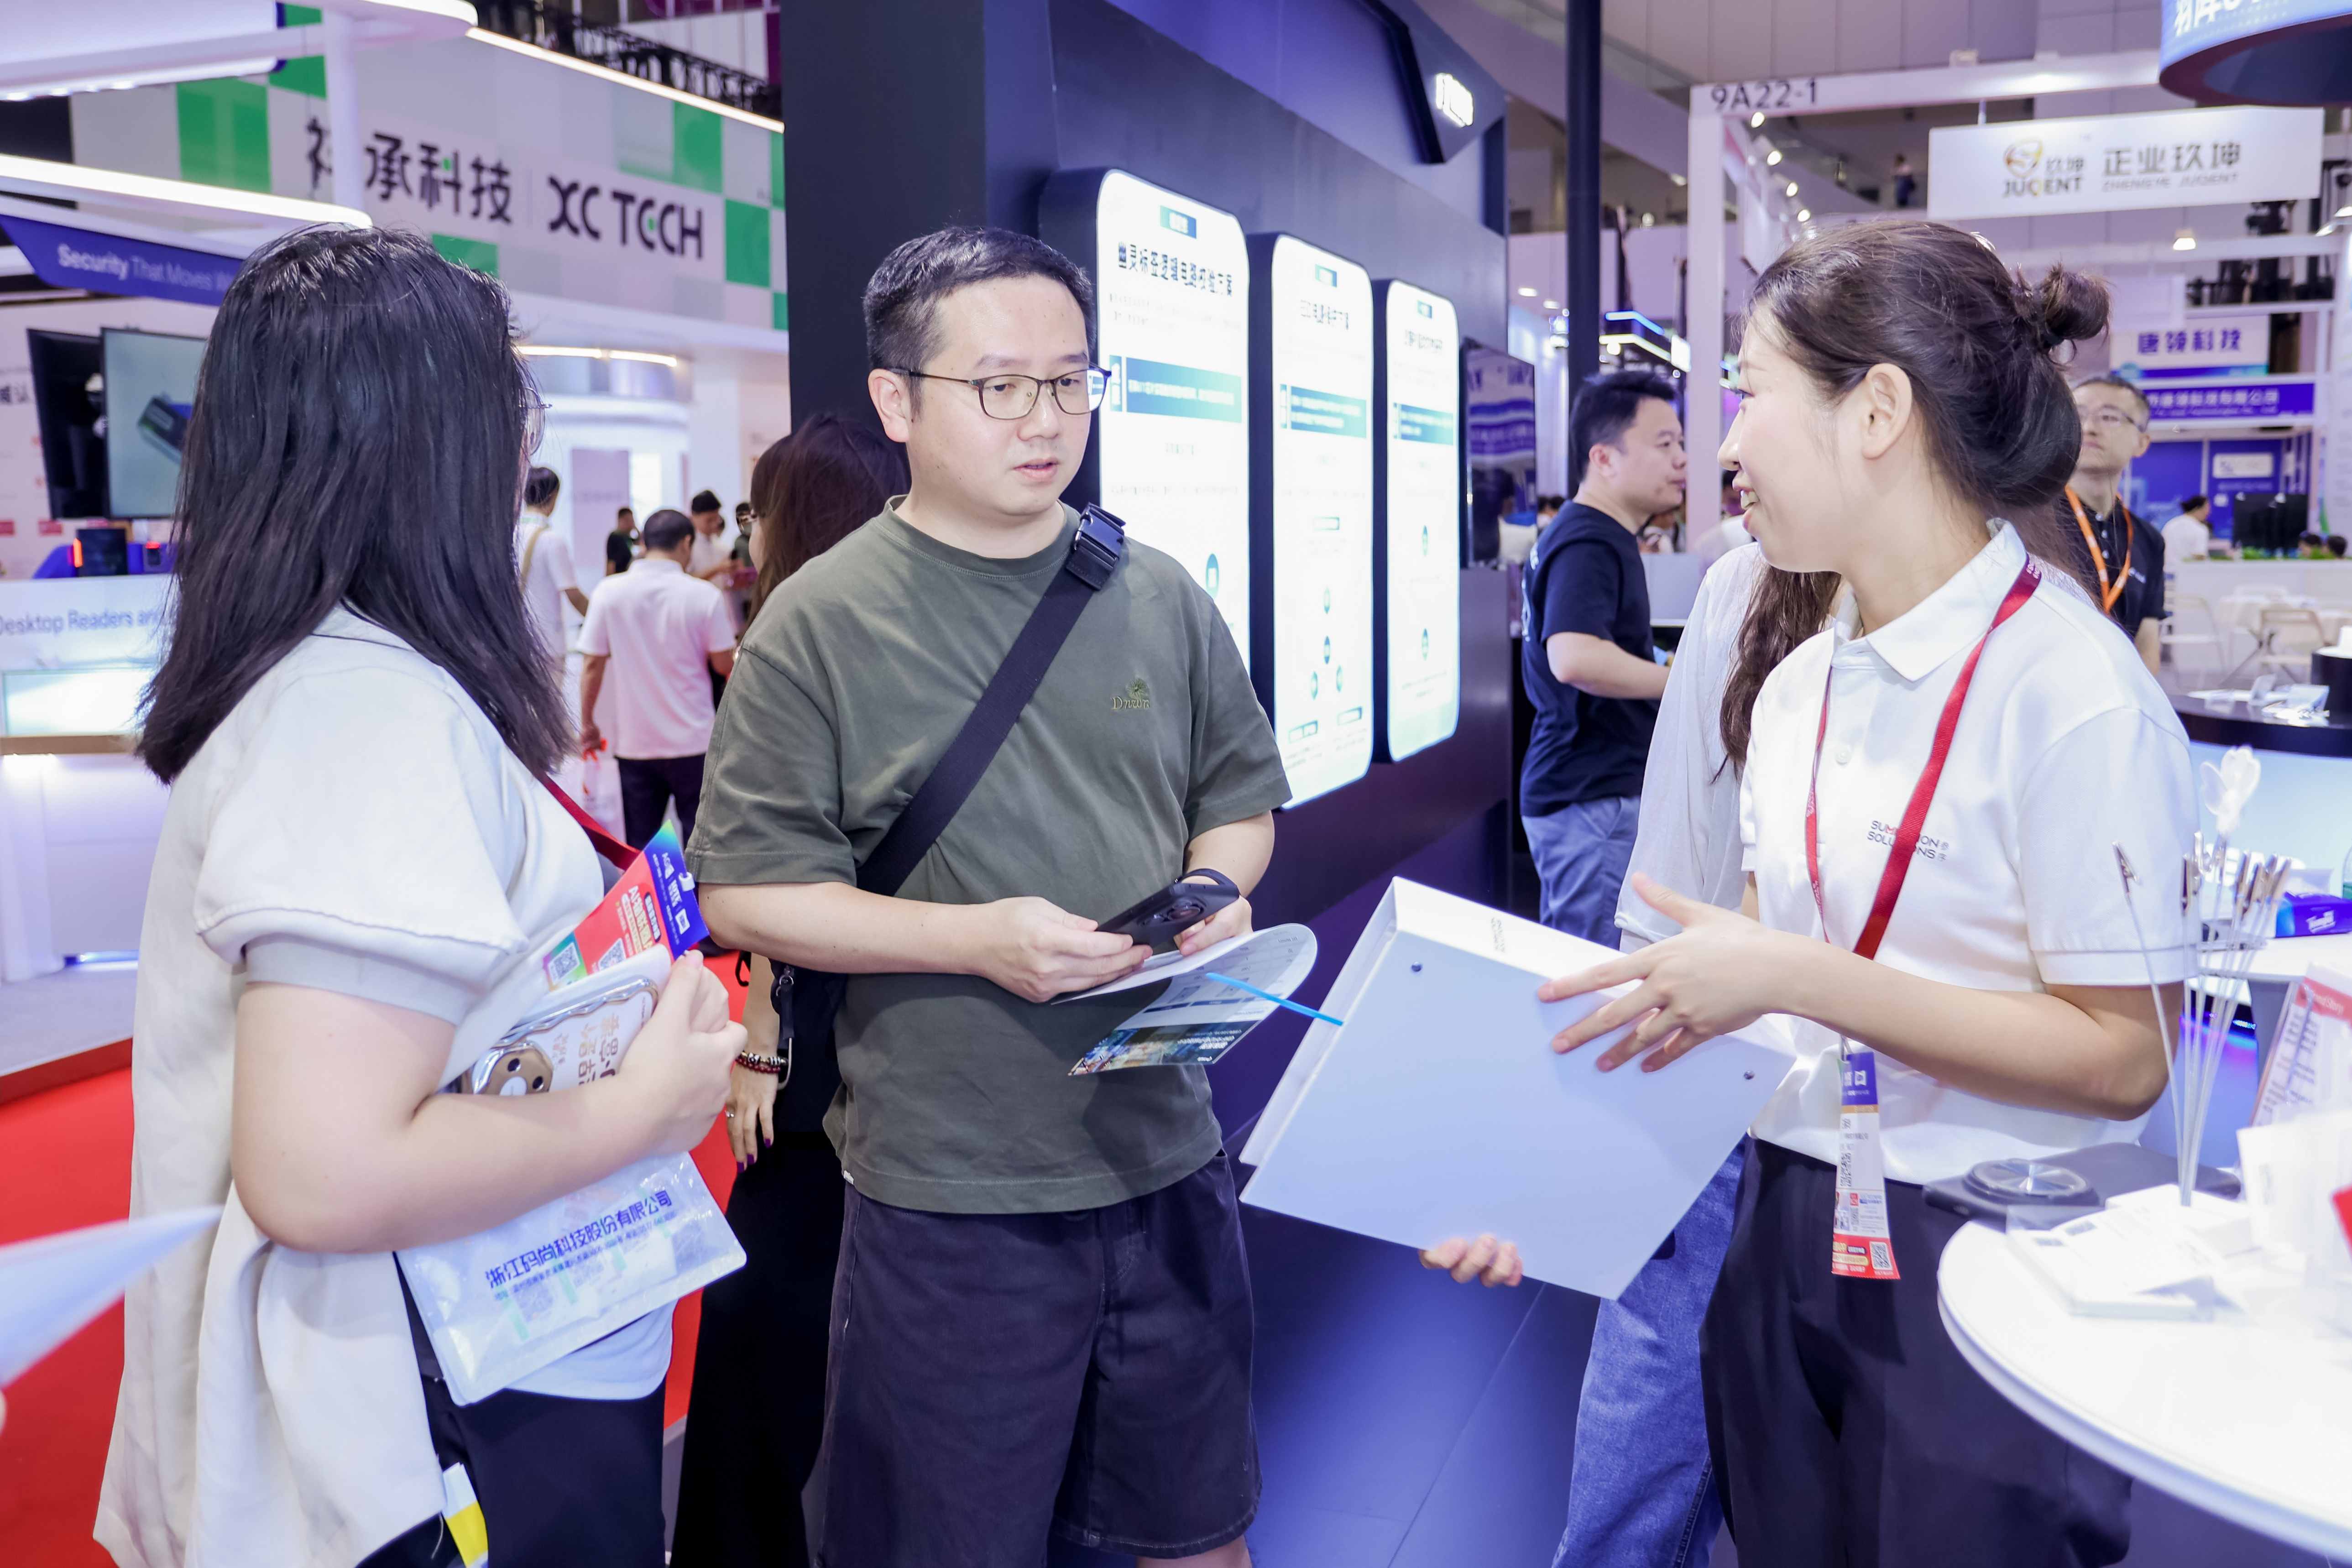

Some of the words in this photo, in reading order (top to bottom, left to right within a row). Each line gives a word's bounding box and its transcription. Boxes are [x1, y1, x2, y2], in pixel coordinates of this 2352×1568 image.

[1710, 76, 1818, 114] 9A22-1
[2104, 142, 2242, 176] 正业玖坤
[548, 174, 601, 239] XC
[58, 243, 128, 281] Security
[485, 1189, 672, 1289] 浙江码尚科技股份有限公司
